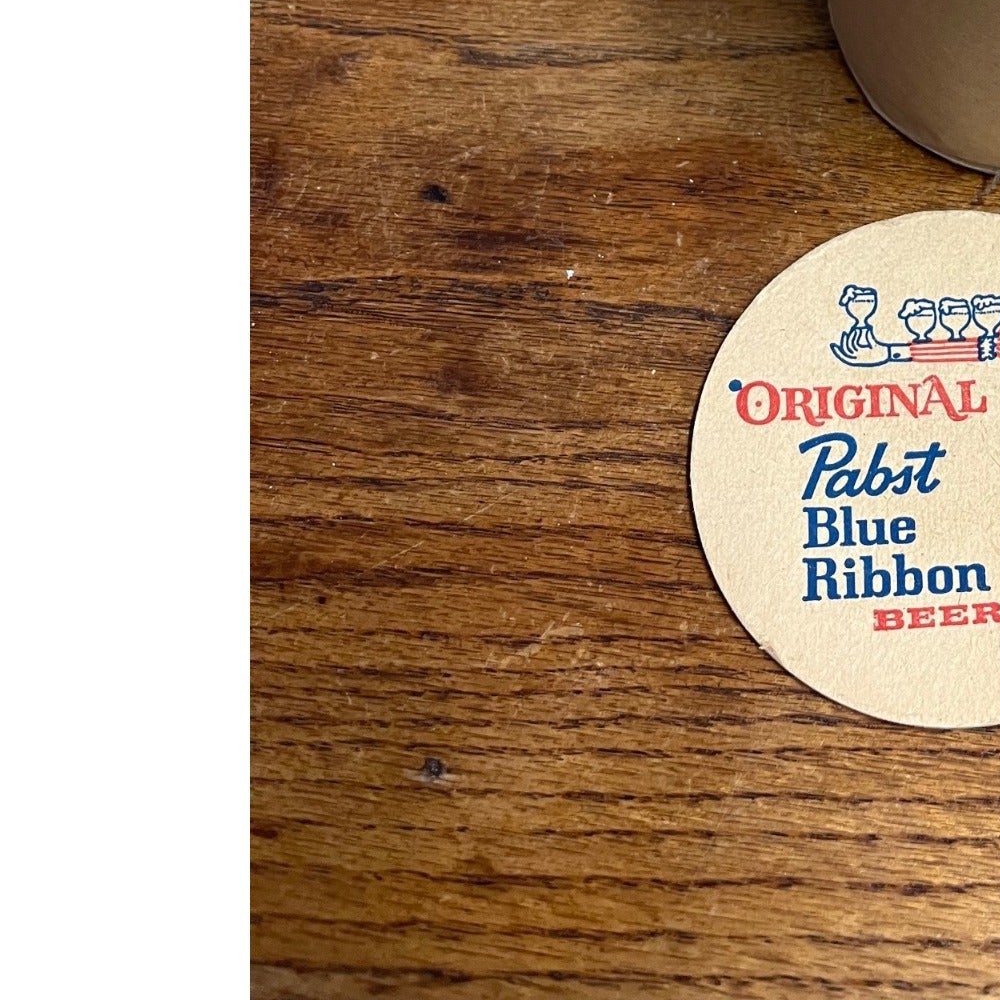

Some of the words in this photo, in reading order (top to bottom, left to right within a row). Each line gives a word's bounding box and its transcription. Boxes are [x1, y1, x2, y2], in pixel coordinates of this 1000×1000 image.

[735, 374, 988, 427] ORIGINAL
[799, 432, 947, 500] Pabst
[802, 506, 917, 549] Blue
[802, 554, 991, 601] Ribbon
